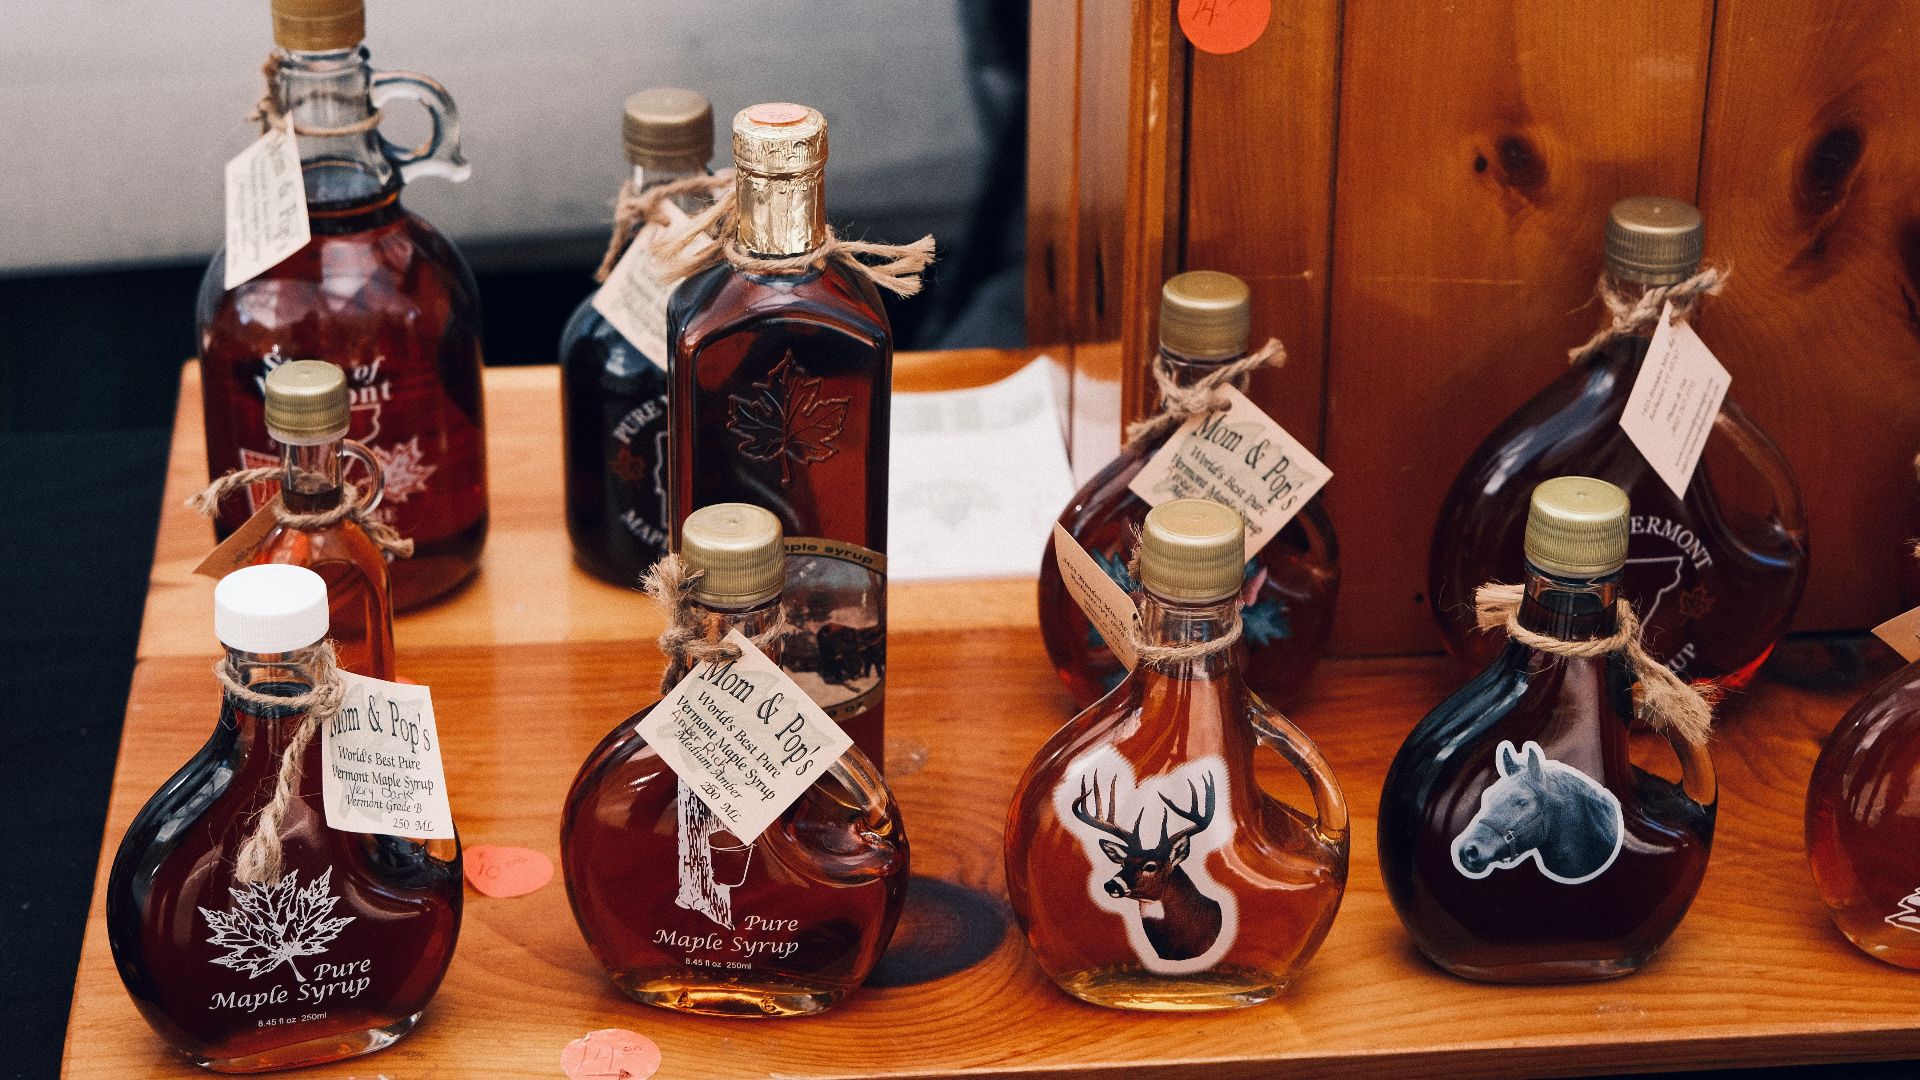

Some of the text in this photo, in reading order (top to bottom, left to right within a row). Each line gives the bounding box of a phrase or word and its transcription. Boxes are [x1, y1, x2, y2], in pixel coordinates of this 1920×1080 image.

[353, 355, 386, 385] of
[613, 399, 663, 445] PURE
[1191, 411, 1304, 511] Mom & Pop's
[823, 545, 874, 565] syrup
[1630, 515, 1713, 570] ERMONT
[330, 694, 431, 755] Mom & Pop's
[699, 657, 821, 776] Mom & Pop's
[671, 709, 730, 773] Amber Rich
[676, 695, 776, 802] Vermont Maple Syrup
[697, 690, 781, 779] World's Best Pure
[338, 745, 422, 771] World's Best Pure
[674, 729, 744, 799] Medium Amber
[332, 764, 434, 795] Vermont Maple Syrup
[349, 782, 415, 801] Very Dark
[346, 794, 423, 814] Vermont Grade B
[720, 802, 743, 823] ML
[393, 818, 434, 832] 250 ML
[744, 914, 799, 932] Pure
[652, 929, 799, 959] Maple Syrup
[313, 959, 372, 981] Pure
[685, 957, 703, 967] 8.45
[705, 959, 710, 967] fl
[726, 961, 752, 970] 250ml
[208, 976, 371, 1013] Maple Syrup
[258, 1011, 327, 1028] 8.45 fl oz 250ml
